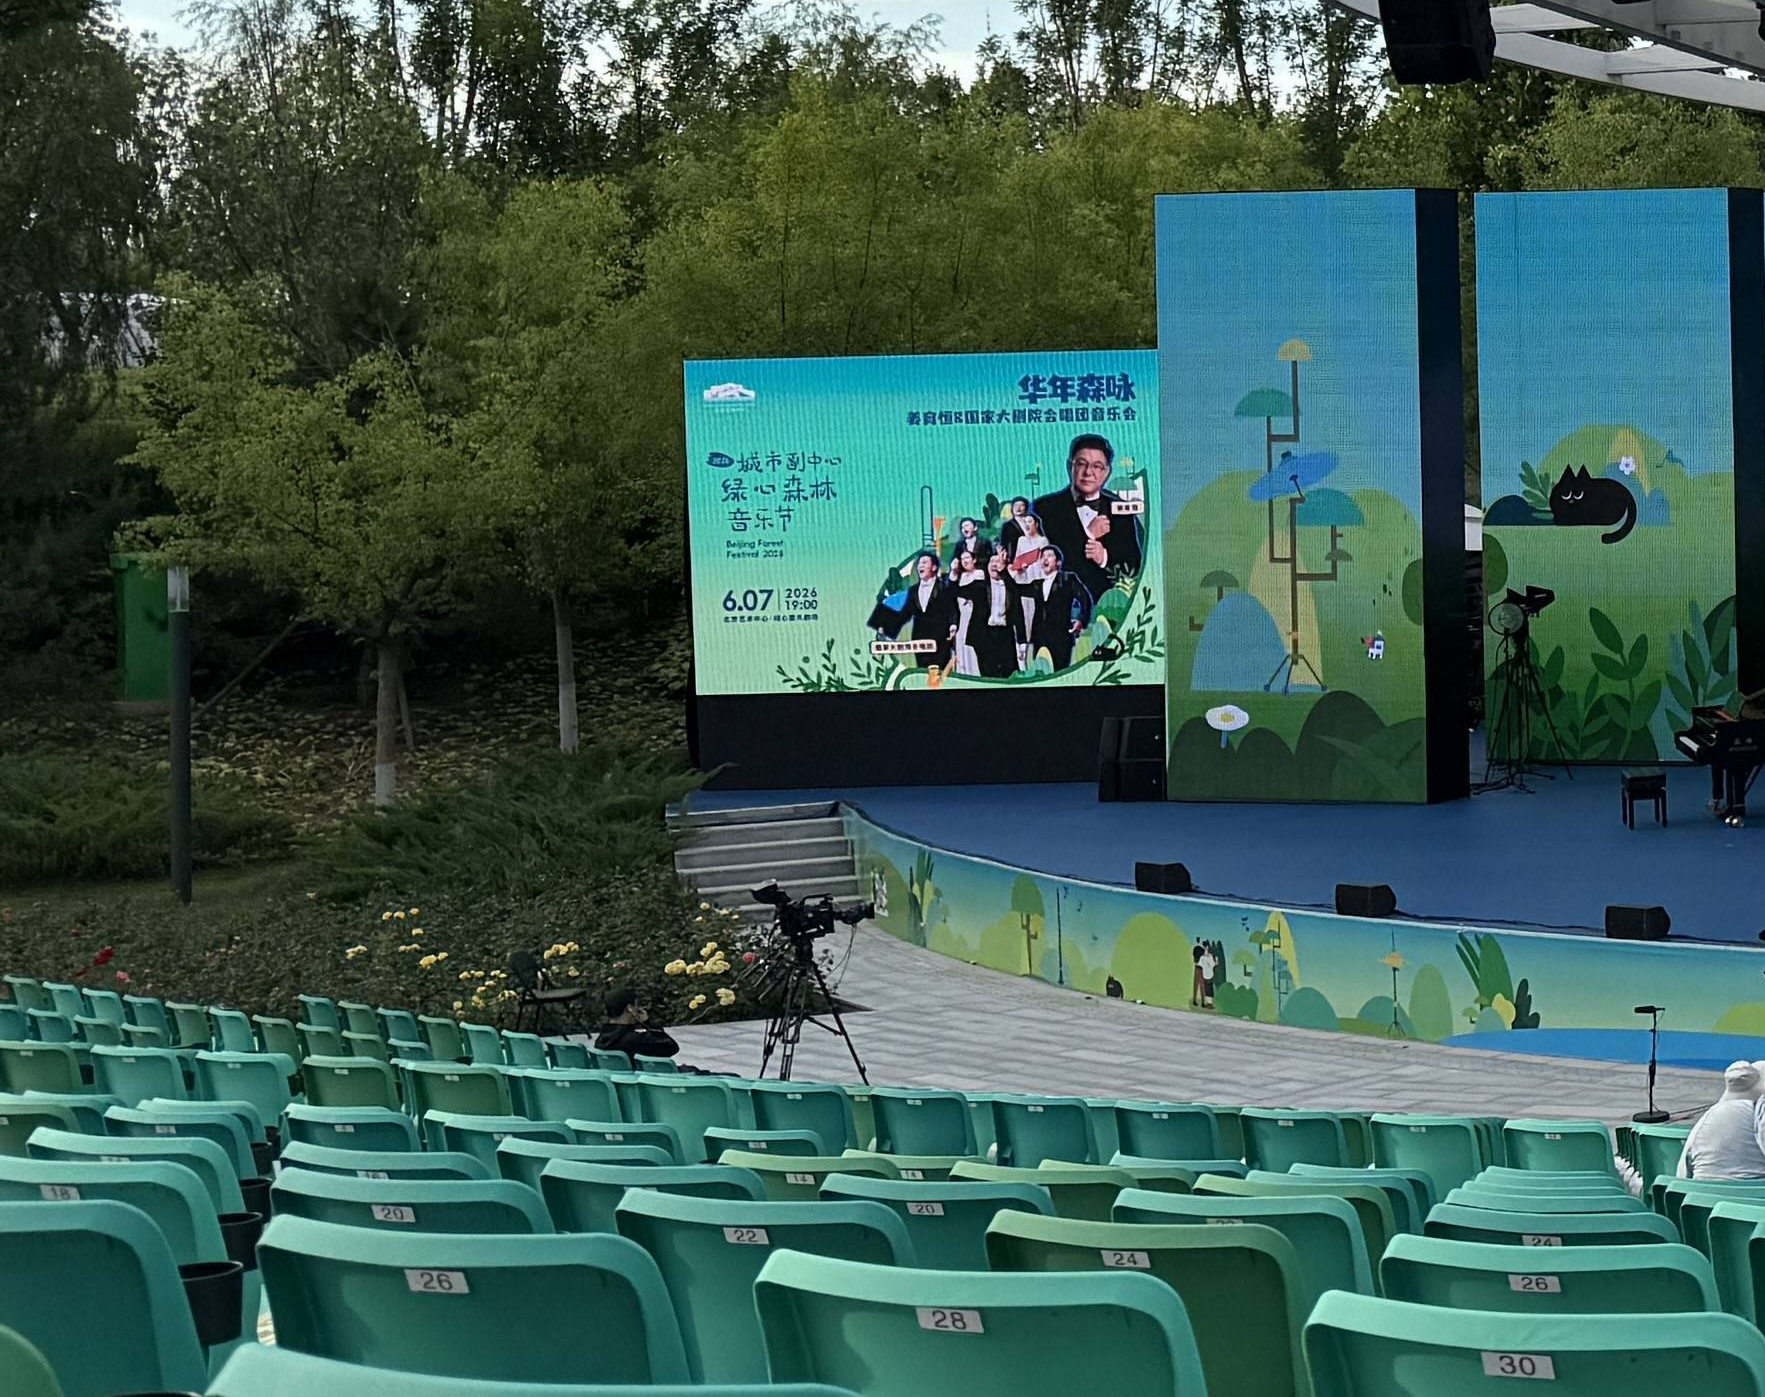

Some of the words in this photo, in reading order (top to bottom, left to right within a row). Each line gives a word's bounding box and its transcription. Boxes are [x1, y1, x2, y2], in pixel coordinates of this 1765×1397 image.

[1016, 371, 1137, 405] 华年森咏
[736, 450, 842, 474] 城市副中心
[720, 473, 838, 504] 绿心森林
[727, 504, 795, 533] 音乐节
[722, 588, 774, 612] 6.07
[785, 587, 818, 599] 2026
[784, 599, 818, 611] 19:00
[380, 1207, 405, 1221] 20
[733, 1229, 759, 1244] 22
[1113, 1253, 1138, 1266] 24
[419, 1271, 454, 1292] 26
[1520, 1276, 1549, 1291] 26
[931, 1309, 967, 1330] 28
[1498, 1354, 1536, 1376] 30
